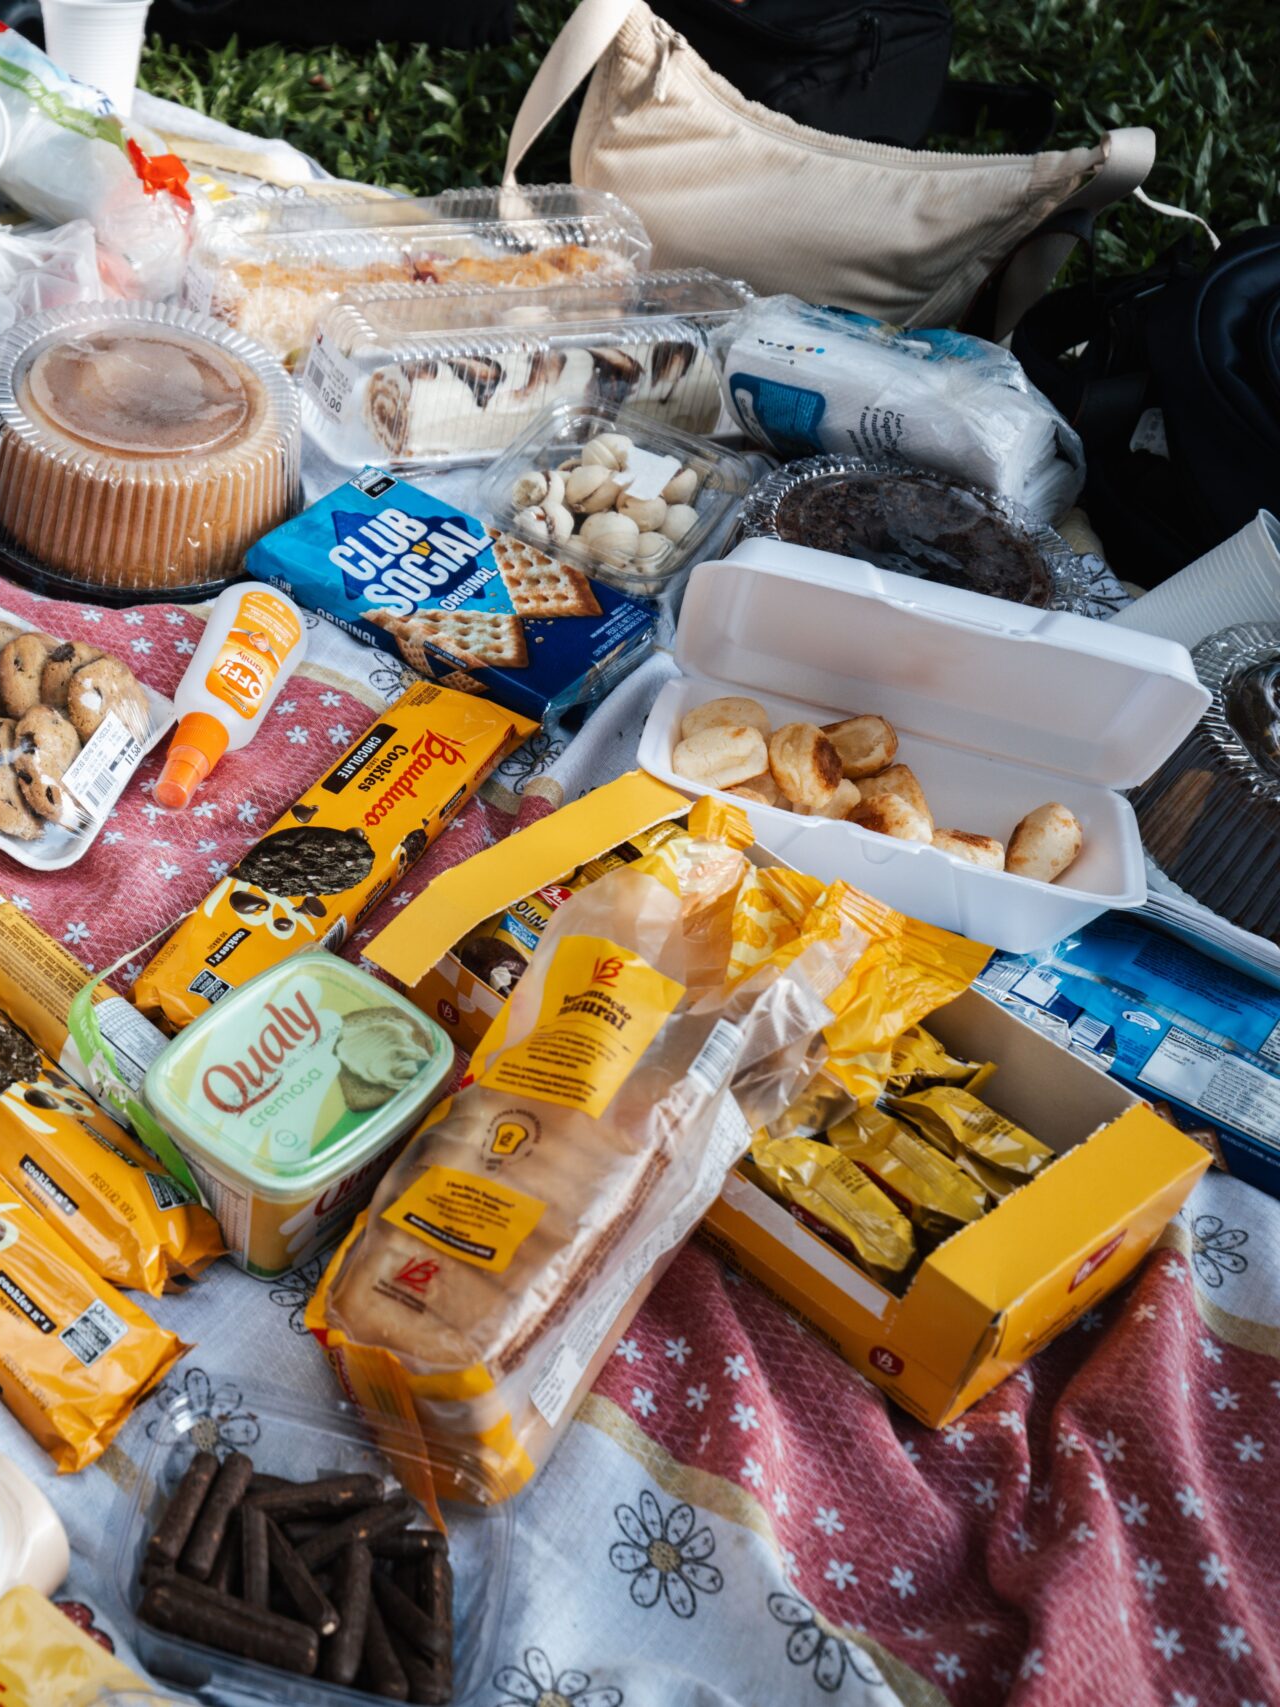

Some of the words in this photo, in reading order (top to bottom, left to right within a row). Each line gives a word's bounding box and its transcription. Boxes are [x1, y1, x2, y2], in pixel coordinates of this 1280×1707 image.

[328, 508, 429, 581] CLUB
[269, 573, 293, 593] CLUB
[363, 521, 494, 618] SOCIAL
[439, 566, 500, 613] ORIGINAL
[317, 607, 381, 649] ORIGINAL
[221, 659, 264, 700] OFF!
[236, 649, 265, 675] family
[337, 735, 382, 780] CHOCOLATE
[358, 745, 409, 792] Cookies
[363, 729, 467, 827] Bauducco
[219, 930, 246, 957] cookies
[202, 990, 322, 1118] Qualy
[249, 1067, 324, 1129] cremosa
[22, 1160, 58, 1197] cookies
